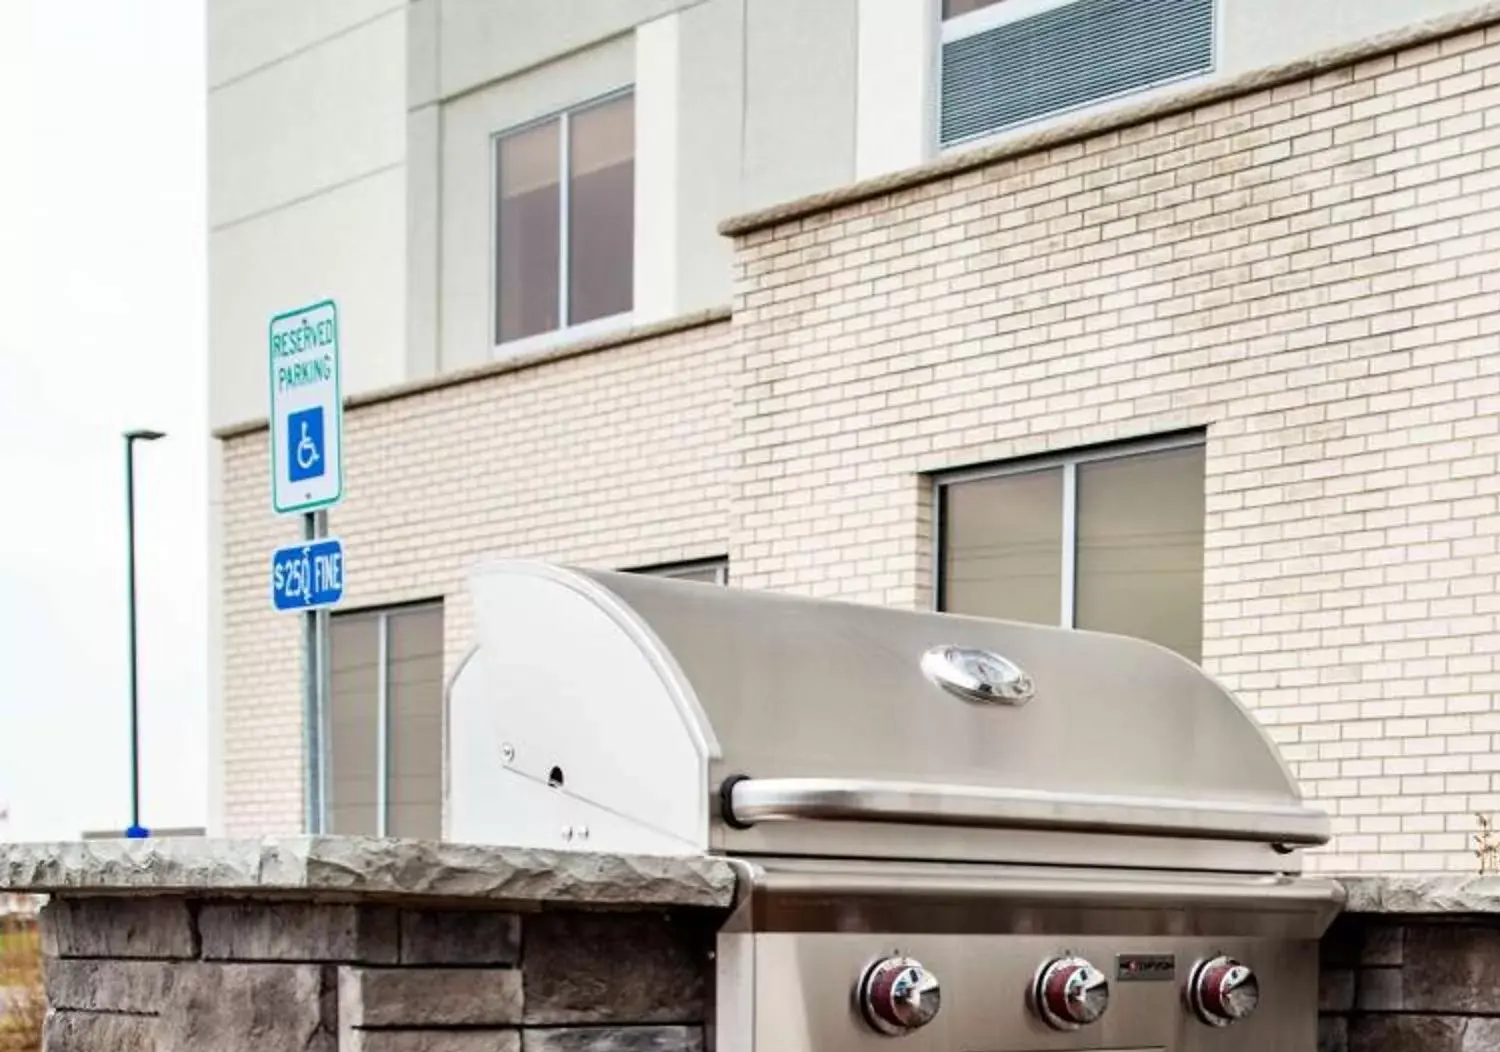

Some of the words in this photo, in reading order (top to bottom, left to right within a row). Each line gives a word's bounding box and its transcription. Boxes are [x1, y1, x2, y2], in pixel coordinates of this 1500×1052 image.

[272, 318, 333, 357] RESERVED
[279, 354, 331, 392] PARKING
[273, 553, 311, 598] $250
[314, 553, 342, 593] FINE
